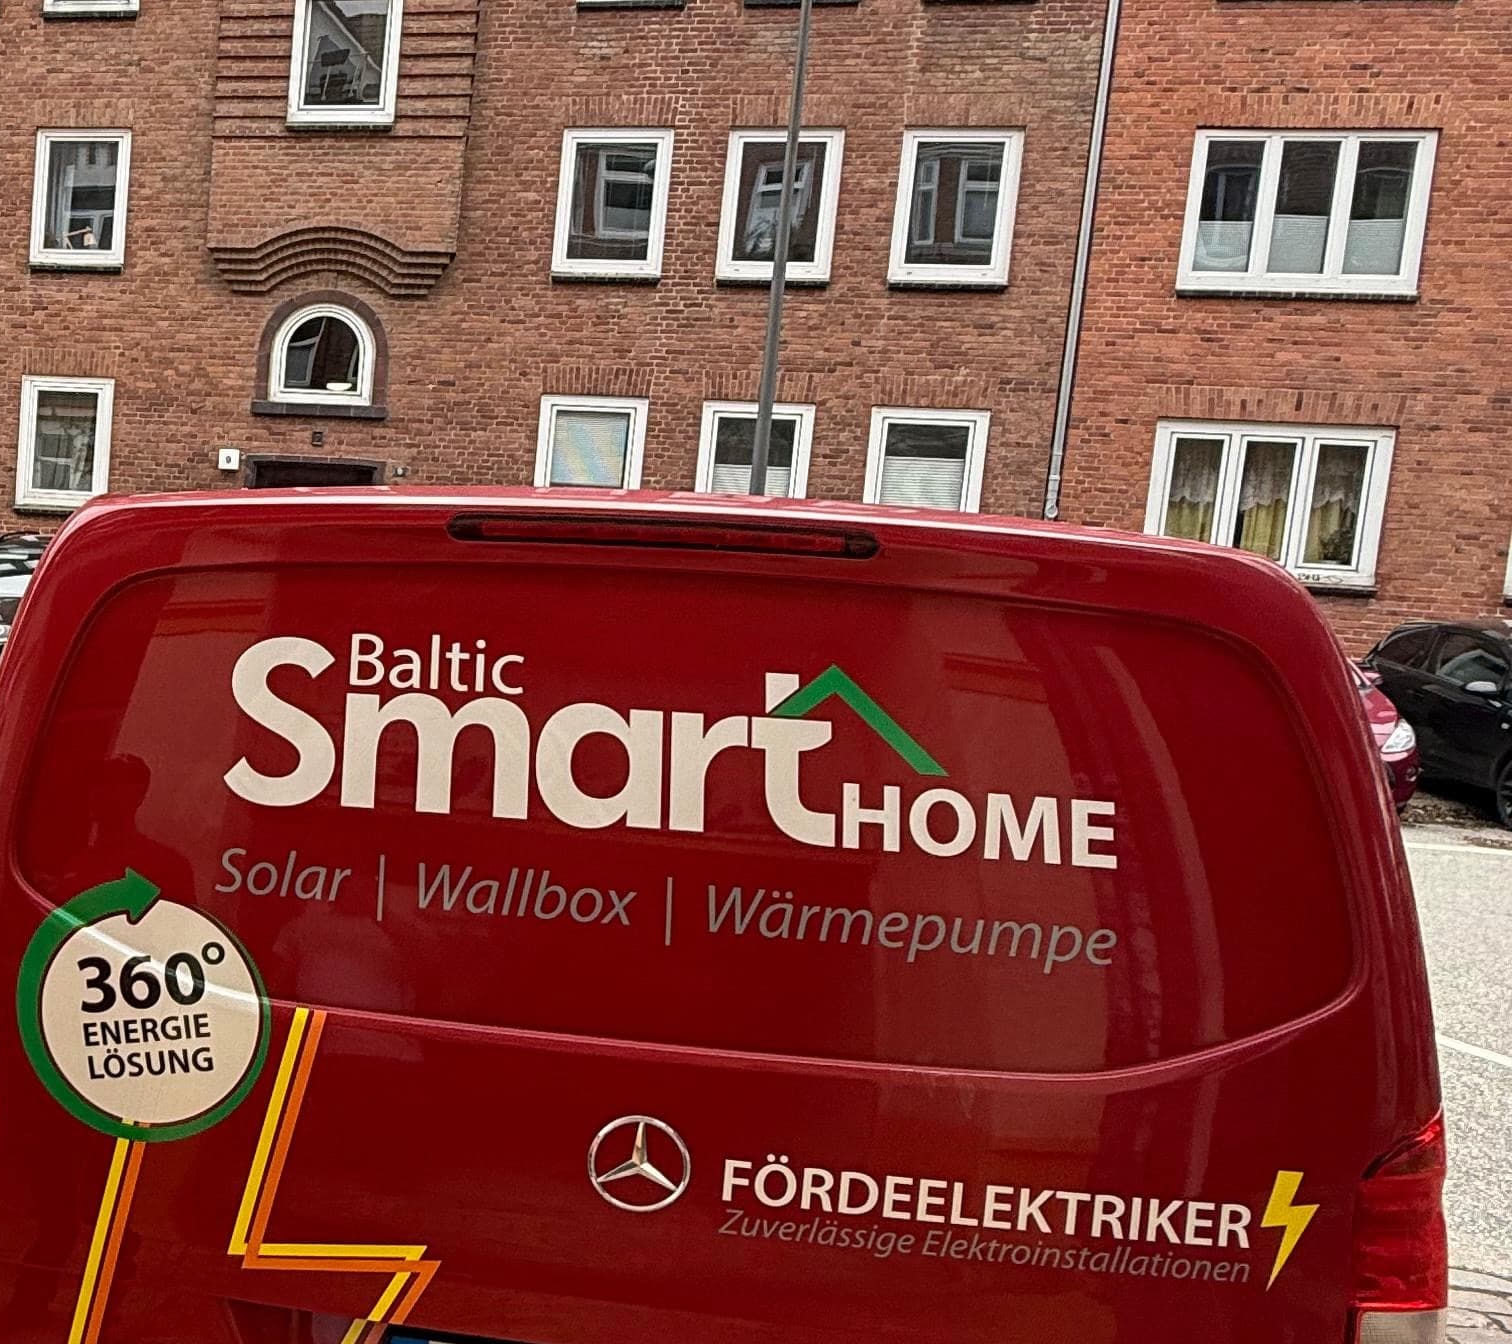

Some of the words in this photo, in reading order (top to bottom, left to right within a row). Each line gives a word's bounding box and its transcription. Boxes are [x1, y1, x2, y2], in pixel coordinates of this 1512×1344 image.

[348, 633, 525, 696] Baltic
[215, 848, 352, 904] Solar
[416, 862, 637, 927] Wallbox
[707, 884, 1118, 974] Wärmepumpe
[77, 942, 225, 1014] 360°
[82, 1013, 211, 1046] ENERGIE
[88, 1047, 214, 1080] LÖSUNG
[721, 1153, 1250, 1249] FÖRDEELEKTRIKER
[718, 1208, 916, 1257] Zuverlässige
[922, 1230, 1250, 1284] Elektroinstallationen
